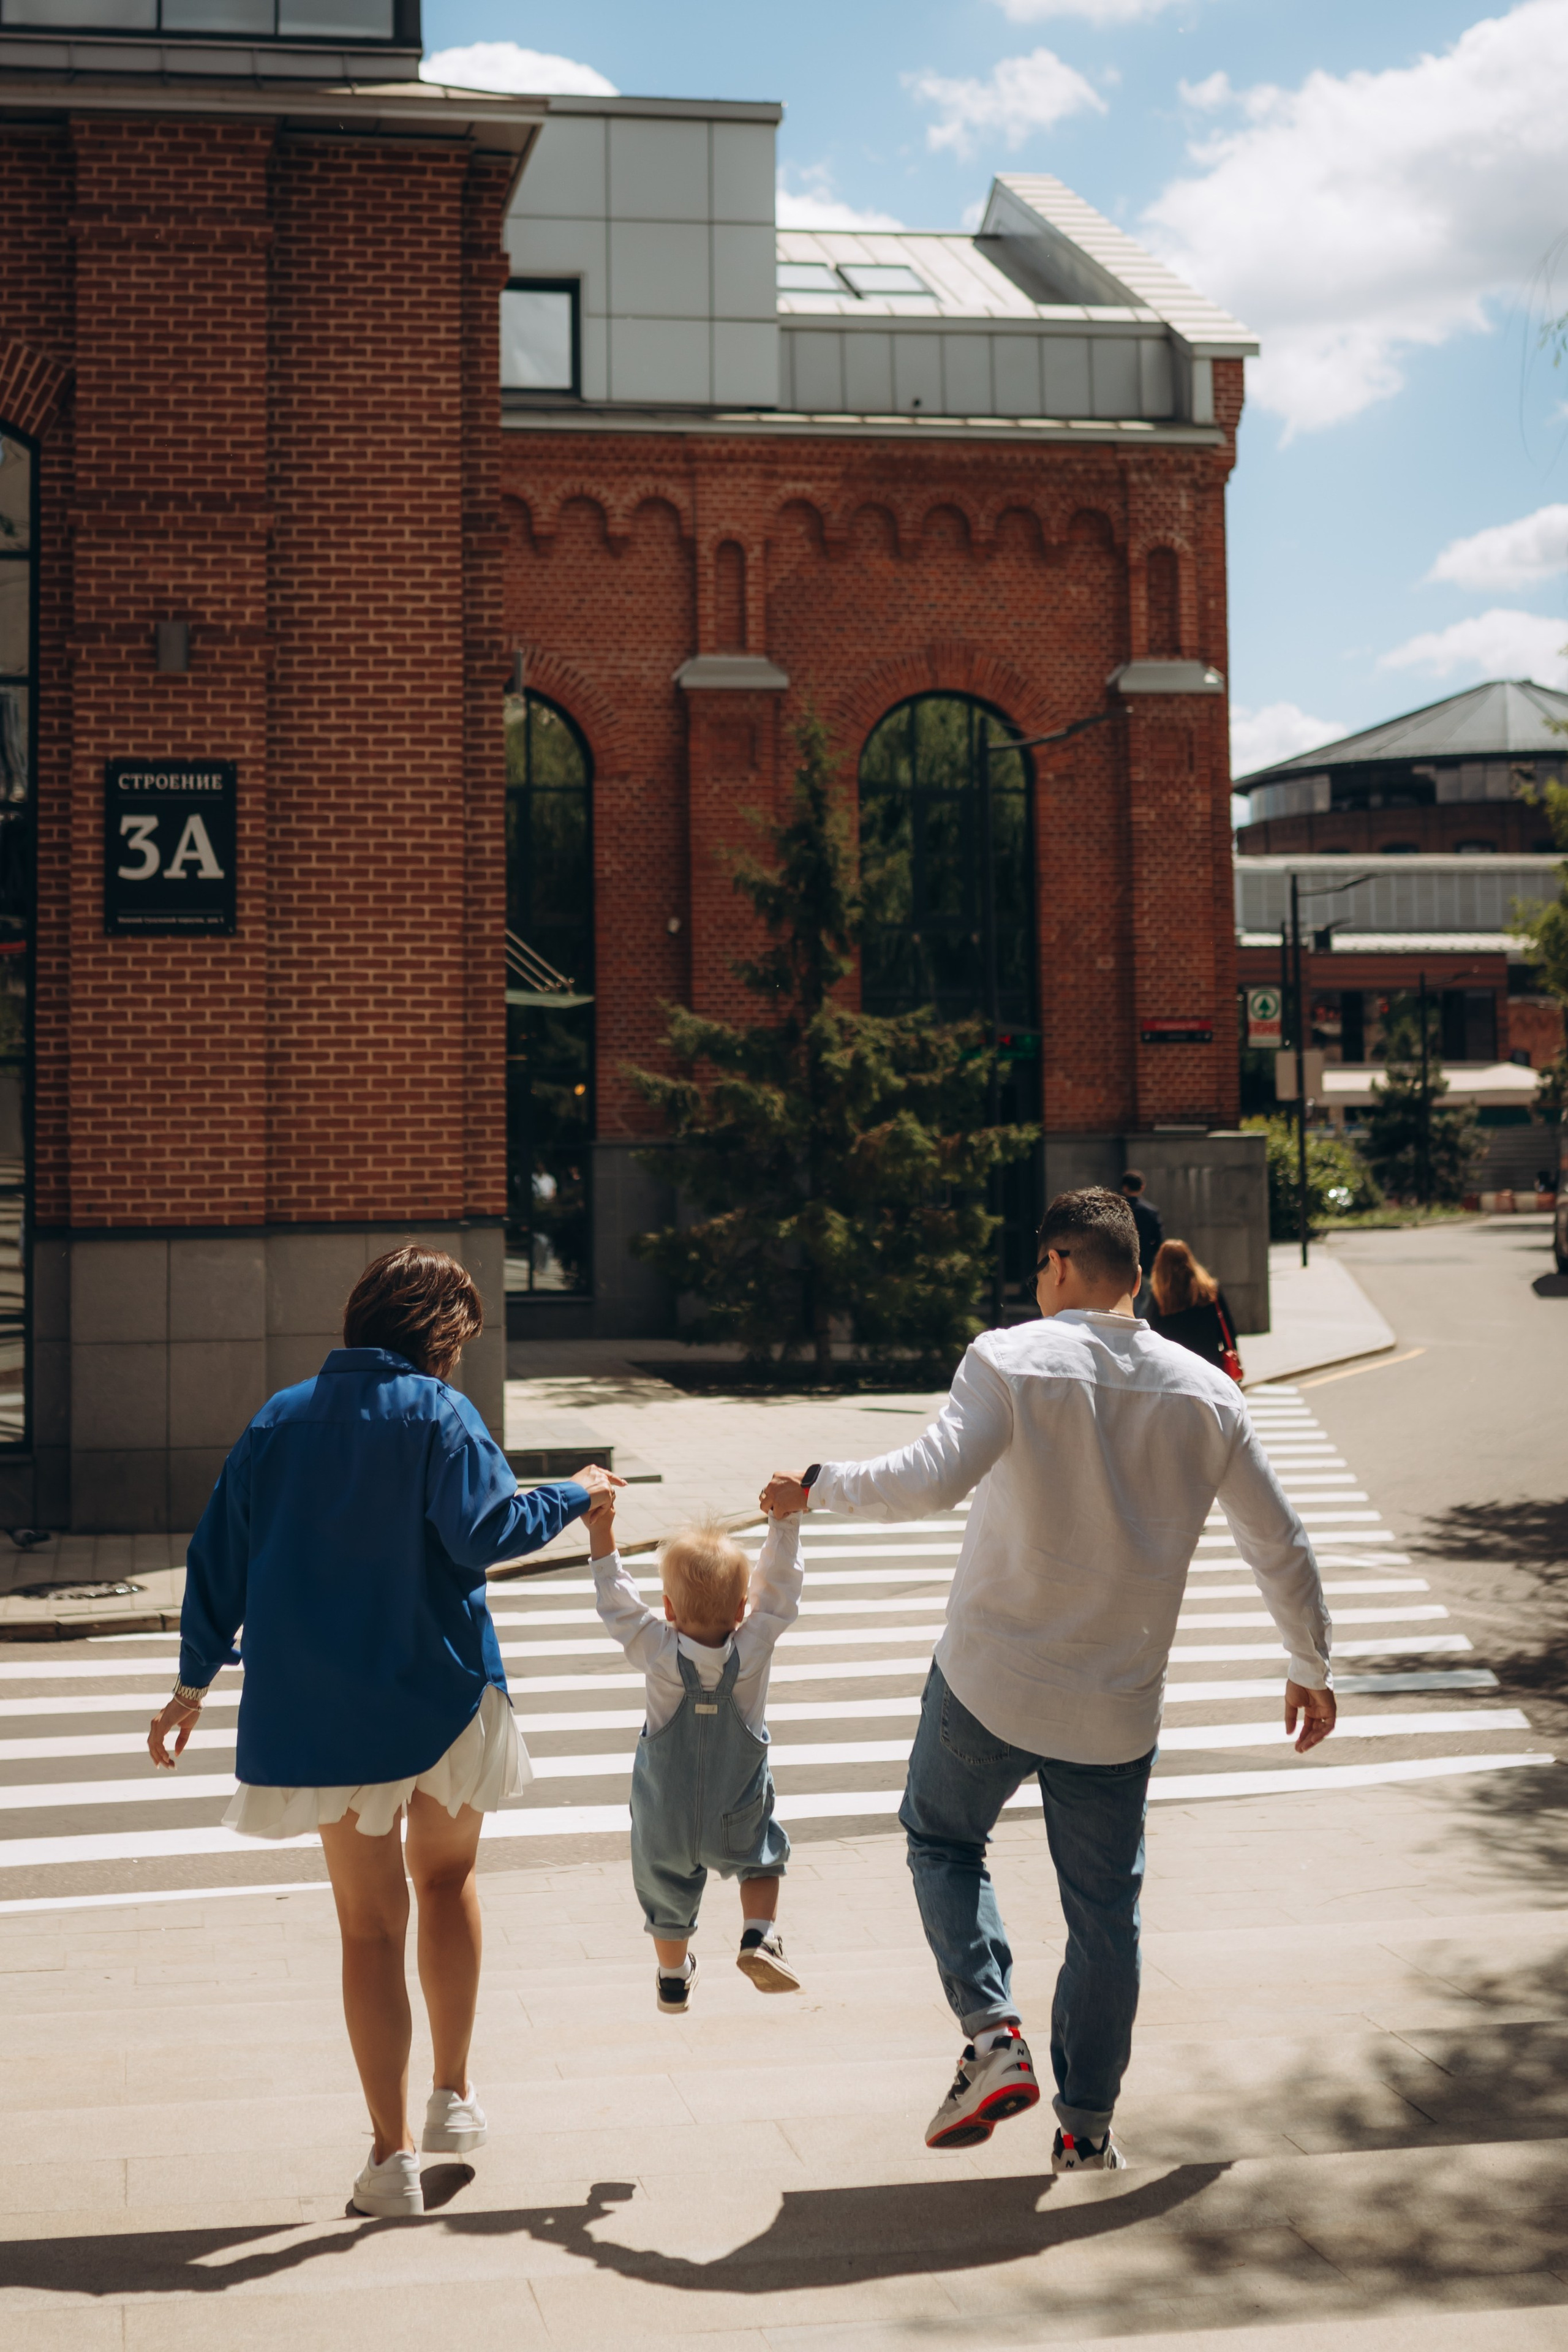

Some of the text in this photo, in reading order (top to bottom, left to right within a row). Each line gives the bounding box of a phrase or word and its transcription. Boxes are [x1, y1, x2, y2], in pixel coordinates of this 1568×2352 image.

[118, 773, 222, 790] СТРОЕНИЕ
[118, 813, 225, 881] 3А
[1066, 2160, 1075, 2168] N
